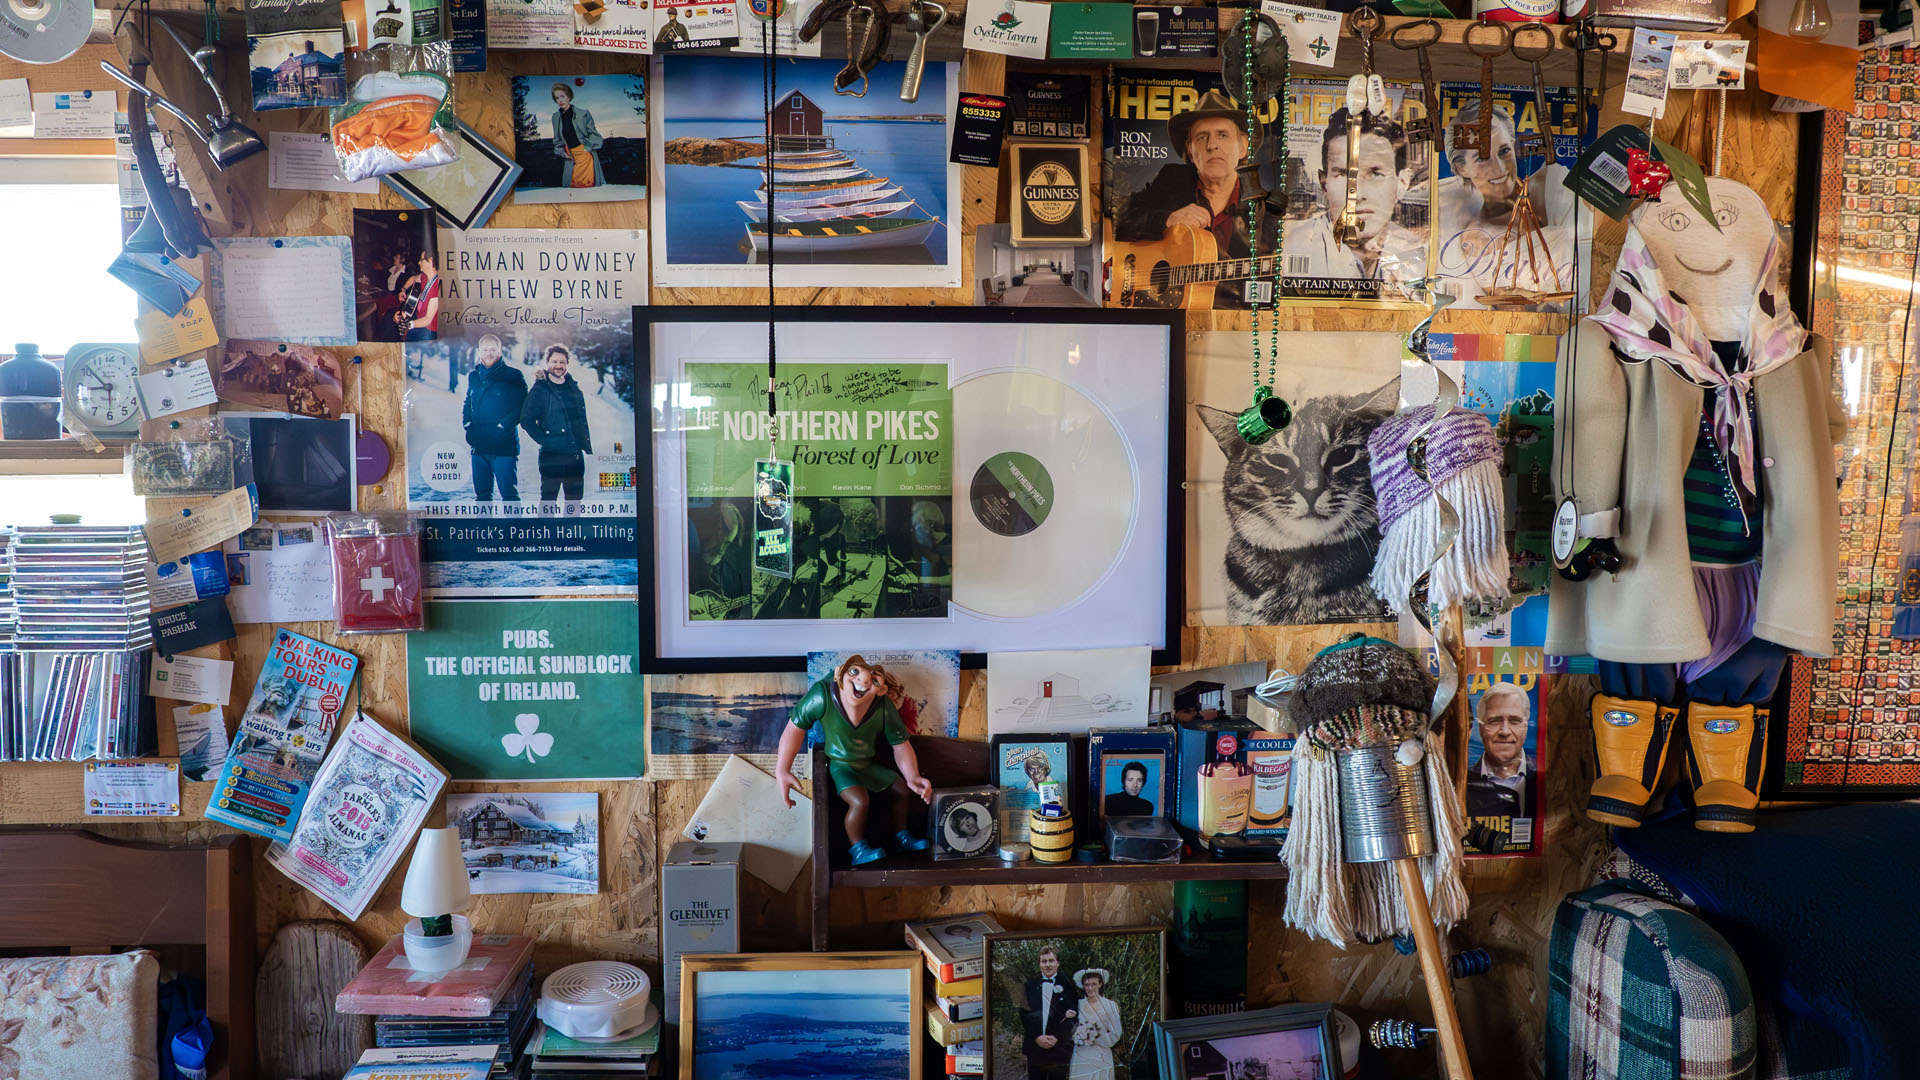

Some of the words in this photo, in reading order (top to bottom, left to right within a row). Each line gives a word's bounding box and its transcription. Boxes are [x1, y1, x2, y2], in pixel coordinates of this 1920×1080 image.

[461, 8, 478, 18] End
[712, 7, 732, 15] FedEx
[1285, 7, 1315, 17] EMIGRANT
[1316, 13, 1337, 21] TRAILS
[1169, 18, 1184, 31] Paddy
[1205, 18, 1216, 30] Bar
[573, 25, 601, 37] orldwide
[602, 25, 622, 38] parcel
[622, 26, 647, 39] delivery
[973, 25, 1005, 41] Oyster
[1006, 30, 1038, 44] Tavern
[574, 36, 628, 48] MAILBOXES
[629, 40, 648, 50] ETC
[700, 39, 721, 47] 20008
[1120, 77, 1136, 85] The
[1137, 77, 1194, 87] Newfoundland
[1028, 90, 1062, 100] GUINNESS
[1443, 90, 1457, 98] The
[962, 107, 1001, 118] 8553333
[1120, 131, 1152, 144] RON
[1120, 145, 1168, 159] HYNES
[1023, 186, 1080, 200] GUINNESS
[502, 235, 552, 244] Entertainment
[554, 235, 584, 244] Presents
[446, 251, 525, 272] ERMAN
[539, 252, 636, 272] DOWNEY
[552, 279, 623, 299] BYRNE
[1282, 279, 1330, 289] CAPTAIN
[441, 304, 500, 325] Winter
[504, 306, 560, 325] Island
[564, 306, 611, 325] Tour
[130, 366, 138, 376] 2
[888, 368, 901, 376] be
[130, 397, 137, 406] 4
[1477, 386, 1494, 408] ULSTER
[91, 407, 98, 416] 7
[106, 411, 113, 420] 6
[121, 406, 128, 416] 5
[697, 411, 719, 427] THE
[724, 410, 858, 441] NORTHERN
[867, 410, 939, 441] PIKES
[437, 452, 456, 460] NEW
[792, 444, 857, 466] Forest
[863, 444, 884, 469] of
[888, 445, 939, 465] Love
[434, 462, 458, 470] SHOW
[431, 472, 461, 481] ADDED!
[1009, 464, 1034, 493] NORTHERN
[1030, 487, 1046, 506] PIKES
[425, 505, 450, 515] THIS
[455, 505, 498, 515] FRIDAY!
[503, 505, 538, 515] March
[542, 504, 562, 515] 6th
[566, 505, 576, 515] @
[580, 504, 604, 514] 8:00
[609, 504, 634, 514] P.M.
[173, 514, 206, 532] JOURNEY
[426, 526, 443, 541] St.
[450, 525, 504, 540] Patrick's
[510, 525, 551, 540] Parish
[556, 525, 587, 541] Hall,
[592, 525, 634, 542] Tilting
[765, 535, 780, 545] ALL
[759, 542, 788, 556] ACCESS
[157, 611, 187, 627] BRUCE
[160, 620, 197, 638] PASHAK
[502, 630, 554, 649] PUBS.
[278, 635, 354, 671] WALKING
[274, 646, 328, 676] TOURS
[330, 670, 340, 678] of
[425, 656, 457, 676] THE
[461, 656, 536, 676] OFFICIAL
[539, 655, 632, 675] SUNBLOCK
[283, 665, 344, 697] DUBLIN
[479, 682, 501, 701] OF
[505, 681, 580, 701] IRELAND.
[245, 718, 284, 742] walking
[1256, 740, 1293, 749] COOLEY
[356, 733, 393, 757] Canadian
[394, 754, 422, 776] Edition
[1253, 763, 1290, 775] KILBEGGA
[362, 792, 374, 802] OLD
[343, 791, 382, 823] FARMER'S
[336, 801, 374, 831] 2015
[328, 813, 367, 841] ALMANAC
[979, 835, 995, 853] CANADA
[691, 901, 710, 910] THE
[670, 907, 731, 921] GLENLIVET
[1184, 1000, 1246, 1016] BUSHMILLS
[958, 1023, 984, 1042] TRAC
